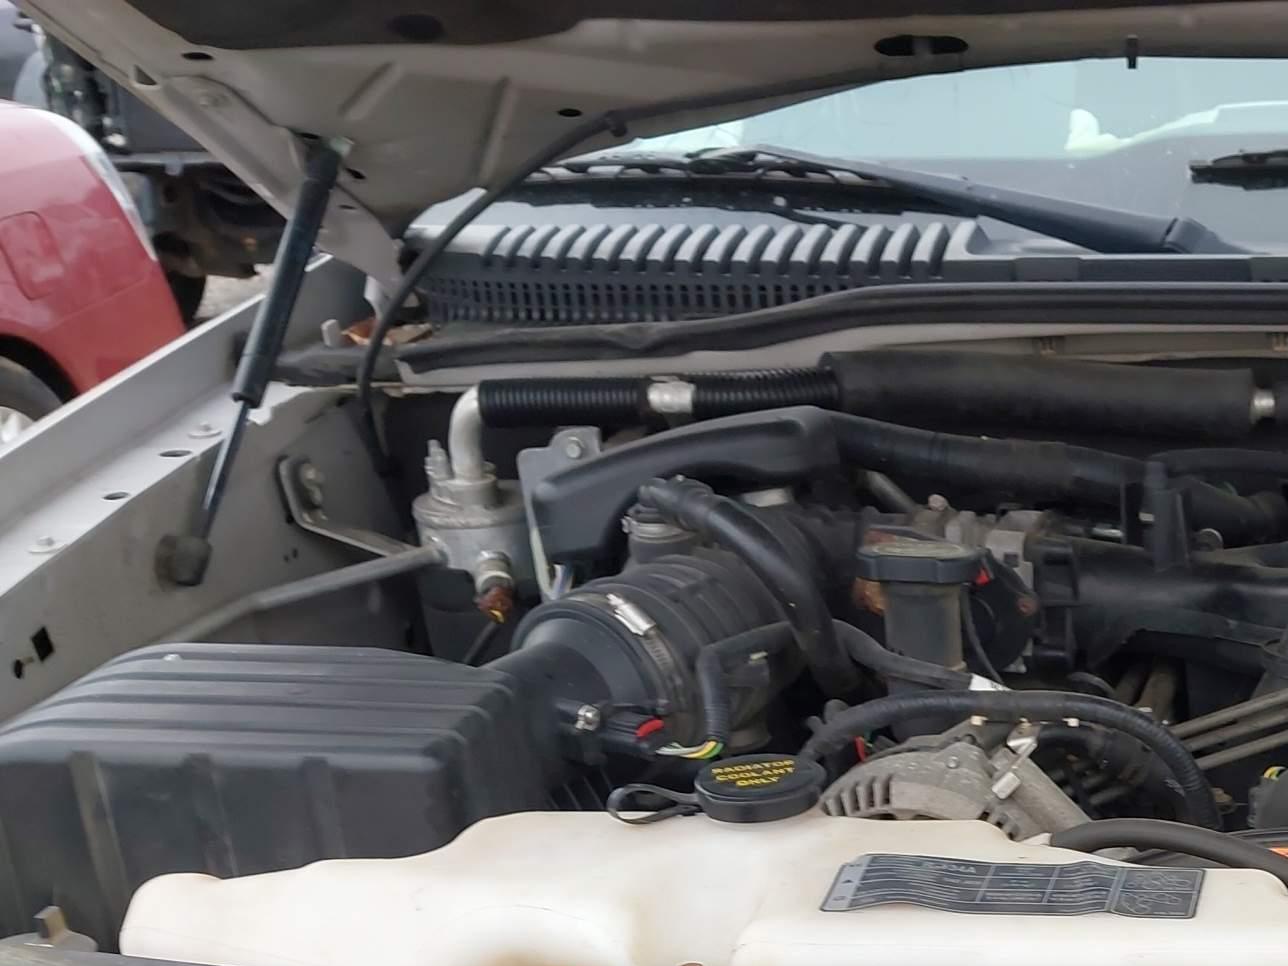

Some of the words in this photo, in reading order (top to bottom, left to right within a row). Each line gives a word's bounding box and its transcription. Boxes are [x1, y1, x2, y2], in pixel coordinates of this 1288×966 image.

[711, 759, 795, 775] RADIATOR
[715, 767, 796, 782] COOLANT
[736, 776, 780, 787] ONLY
